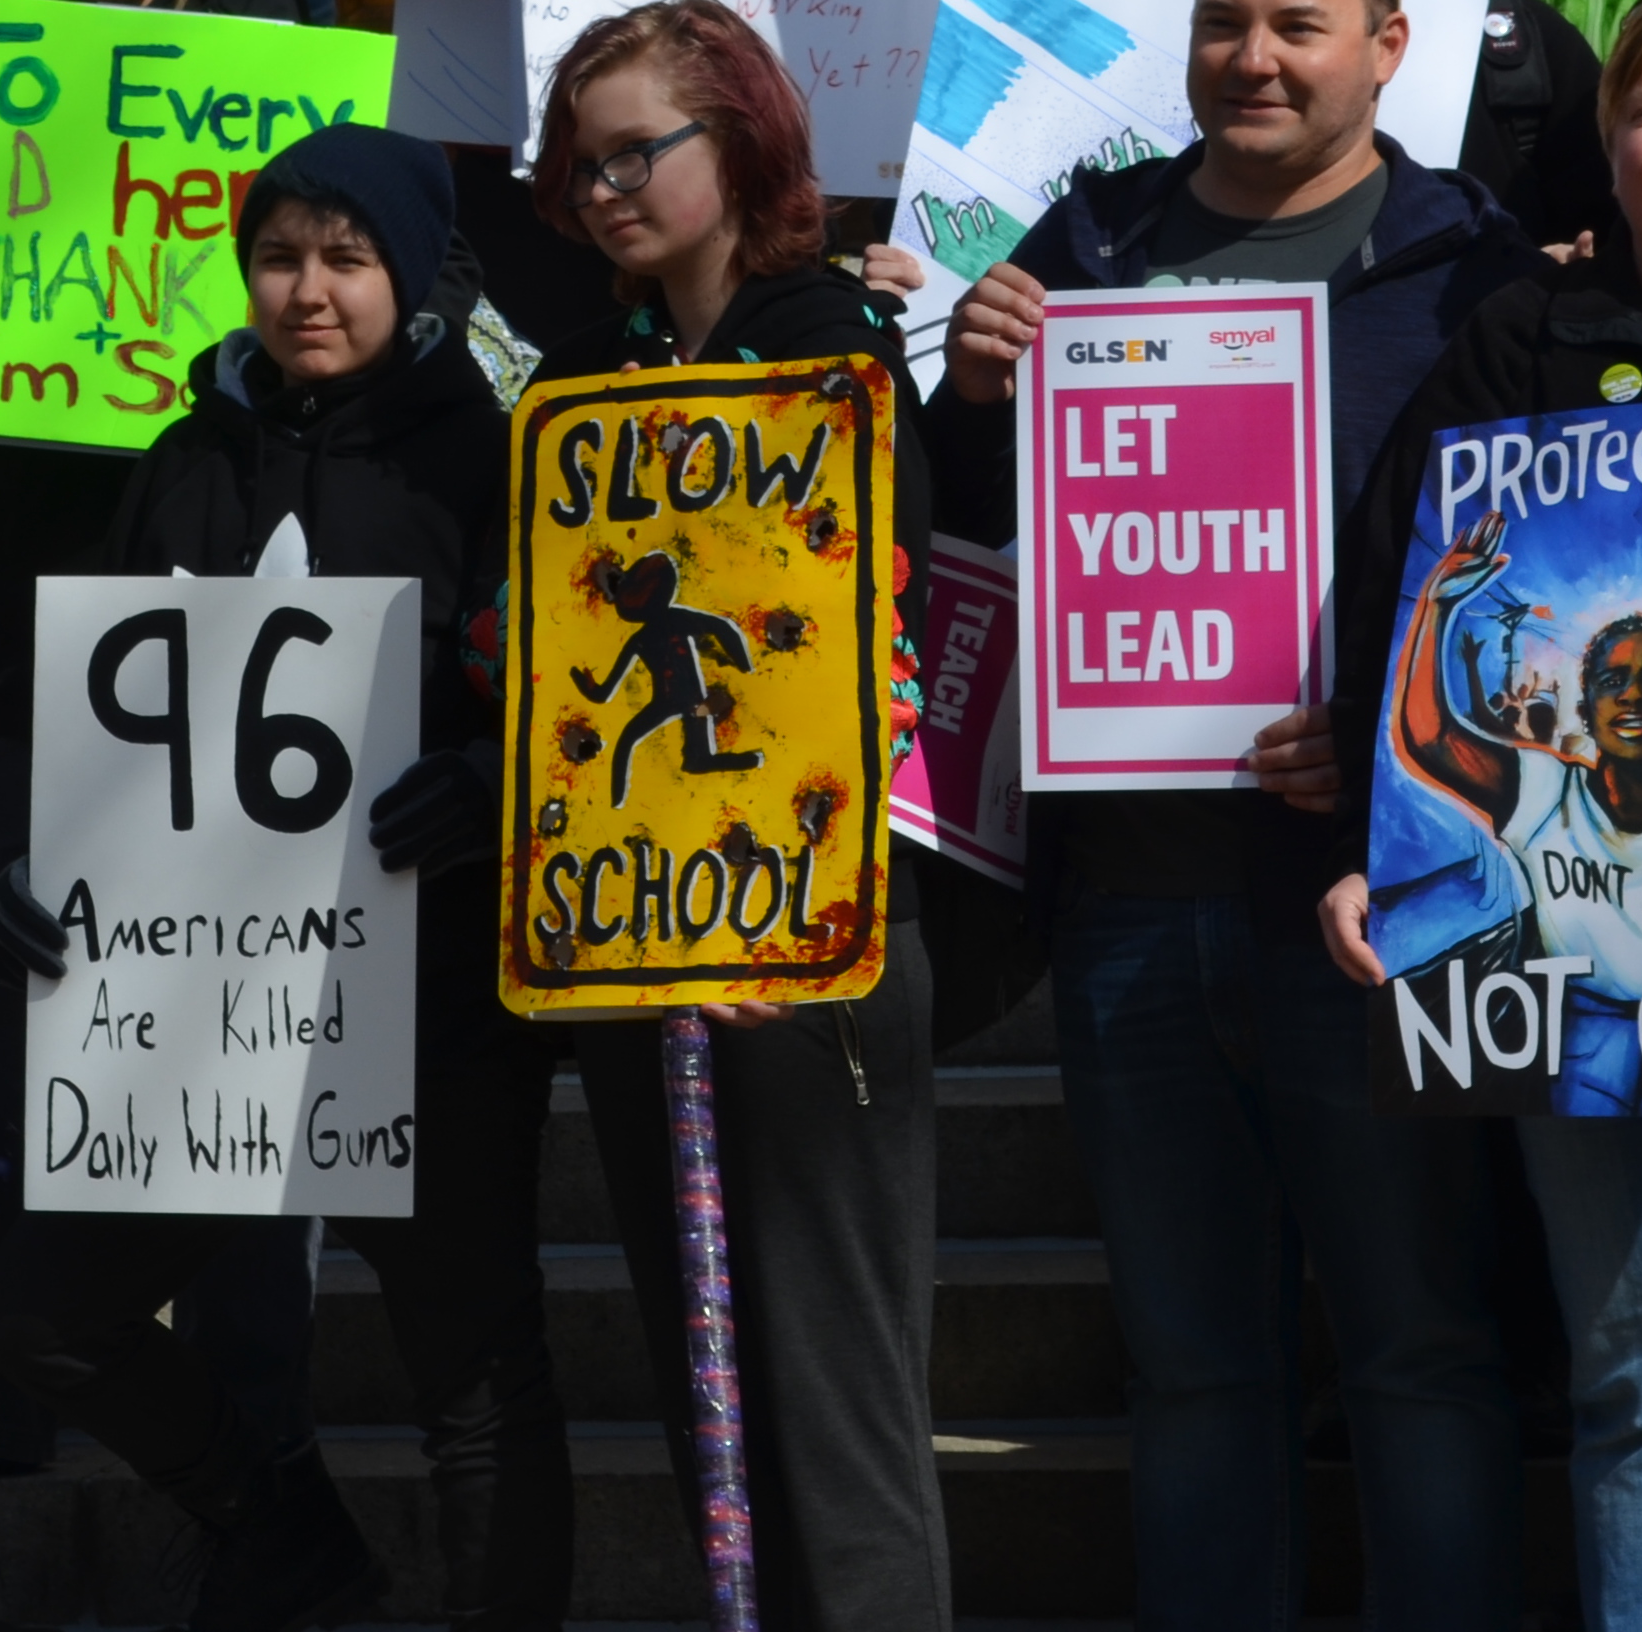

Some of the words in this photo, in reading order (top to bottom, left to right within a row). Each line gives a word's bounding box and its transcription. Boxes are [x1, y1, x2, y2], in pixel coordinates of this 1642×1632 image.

[106, 43, 355, 155] Every
[1065, 339, 1173, 366] GLSEN
[1208, 325, 1276, 350] smyal
[547, 414, 832, 530] SLOW
[1065, 404, 1177, 478] LET
[1067, 508, 1287, 577] YOUTH
[1067, 608, 1235, 685] LEAD
[86, 605, 354, 834] 96
[532, 843, 836, 948] SCHOOL
[81, 977, 157, 1054] Are
[1392, 954, 1596, 1093] NOT
[45, 1076, 159, 1190] Daily
[182, 1085, 283, 1176] With
[305, 1089, 416, 1172] Guns
